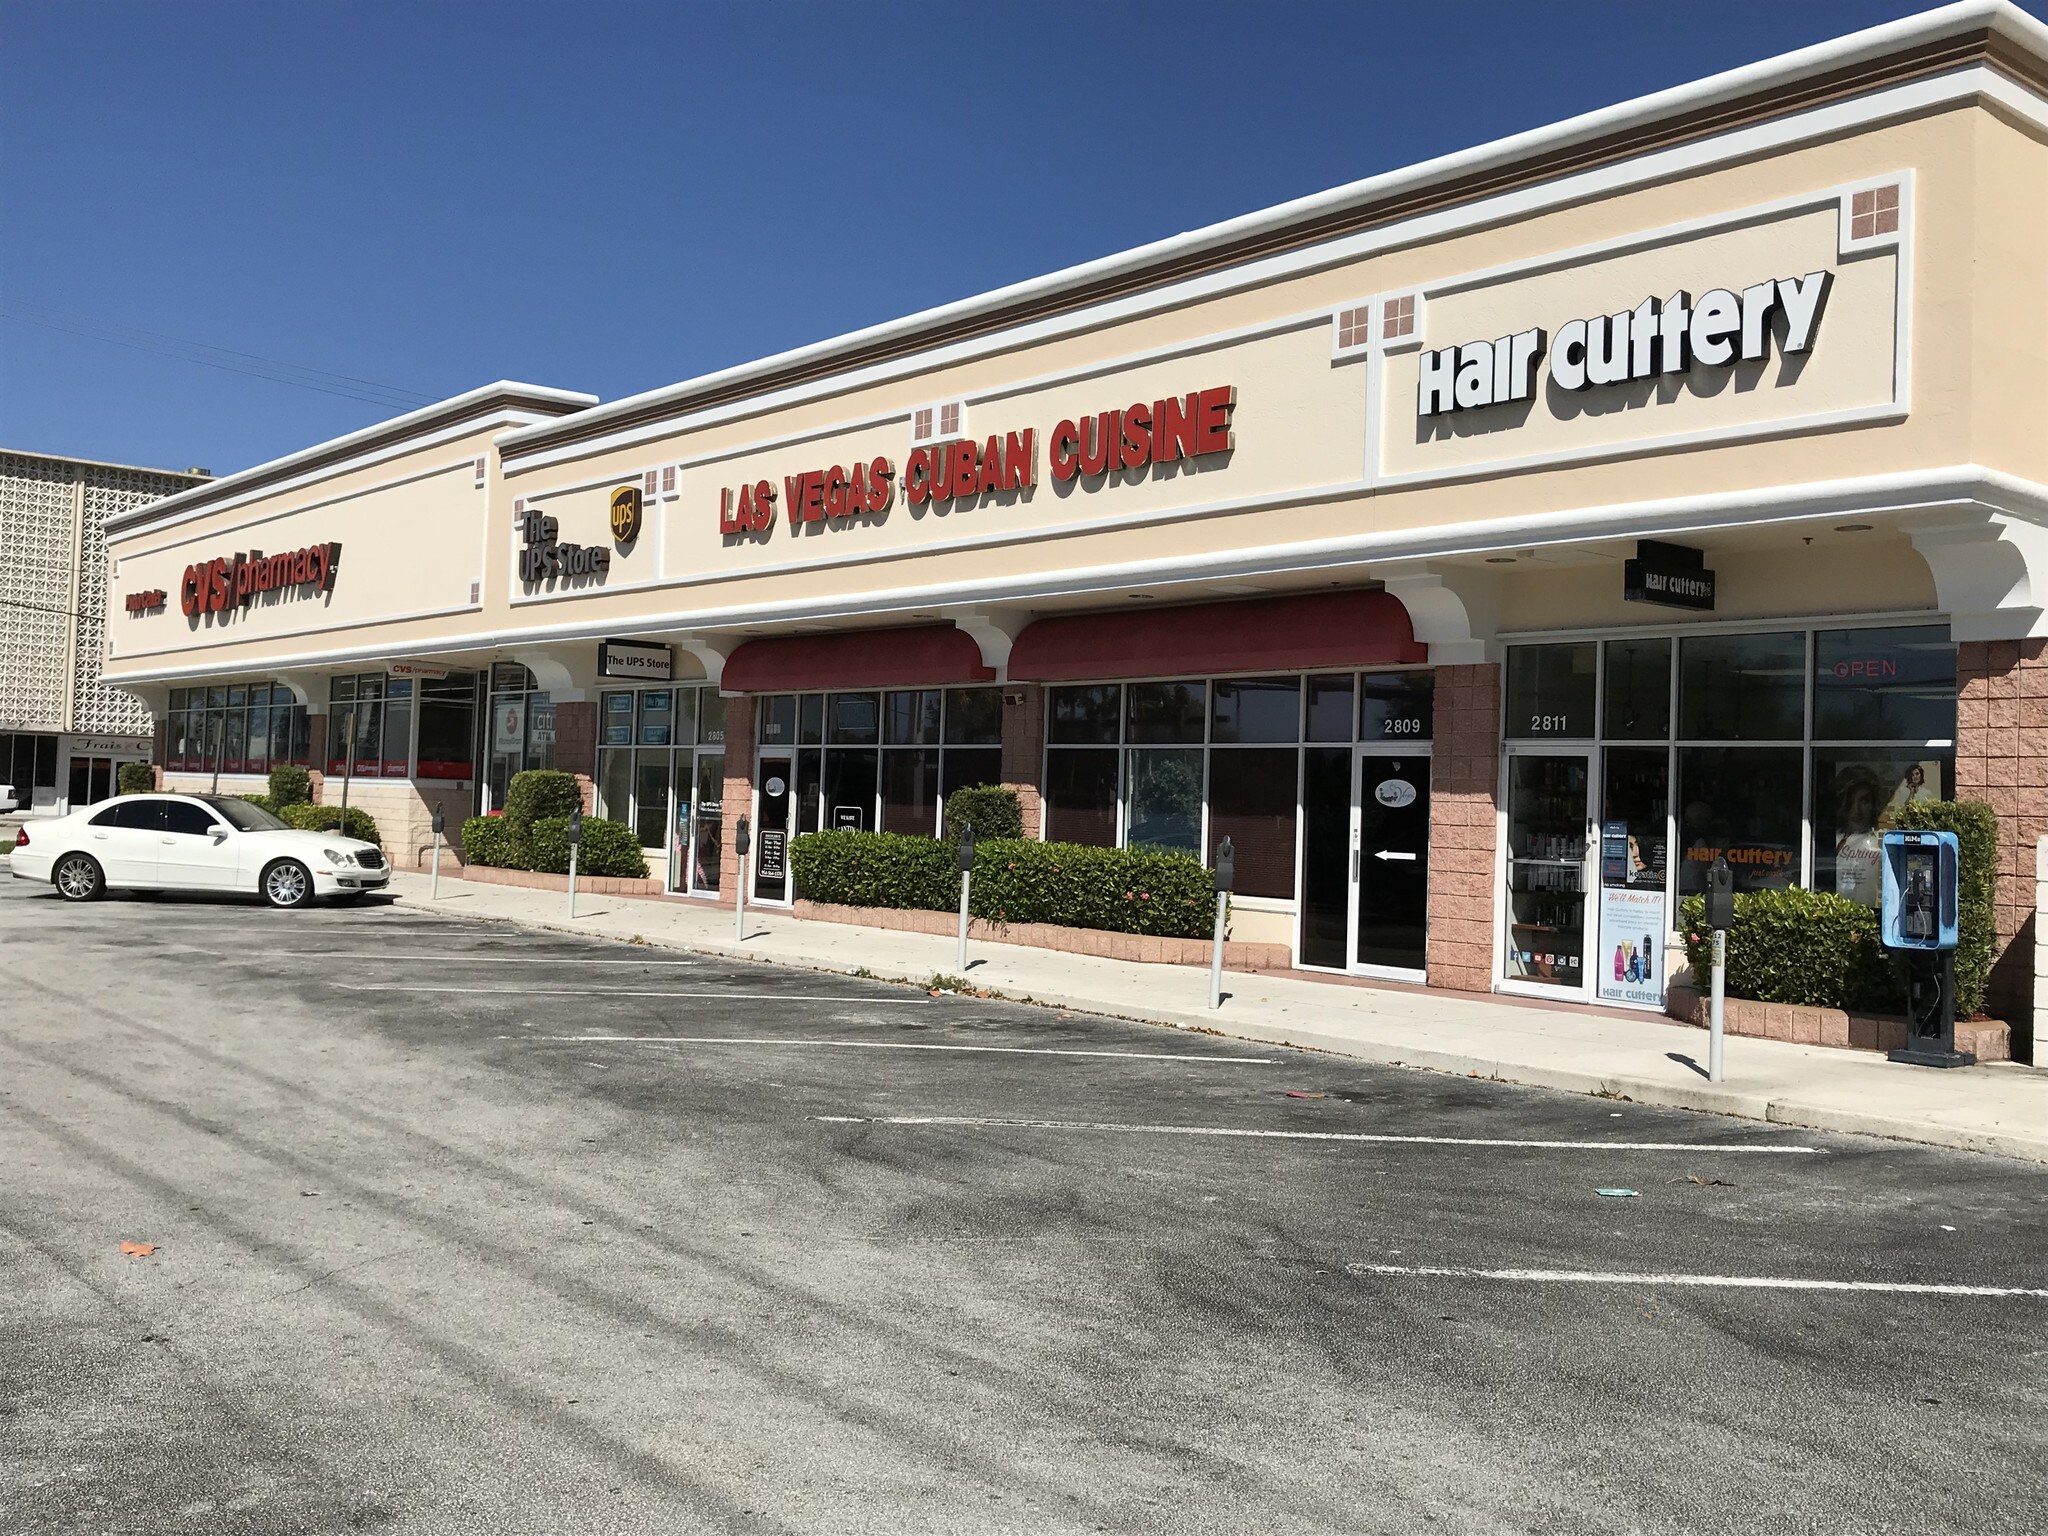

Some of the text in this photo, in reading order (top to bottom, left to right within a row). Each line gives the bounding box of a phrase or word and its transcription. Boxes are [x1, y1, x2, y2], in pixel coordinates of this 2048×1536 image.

[1419, 270, 1830, 416] Hair cuttery
[720, 386, 1236, 534] LAS VEGAS CUBAN CUISINE
[522, 510, 554, 543] The
[612, 503, 633, 534] ups
[519, 543, 602, 582] UPS Store
[181, 543, 335, 616] CVS/pharmacy
[1645, 573, 1668, 591] Hair
[607, 655, 670, 669] The UPS Store
[1834, 660, 1896, 677] OPEN
[1384, 719, 1421, 733] 2809
[1531, 715, 1567, 731] 2811
[708, 730, 725, 741] 2805
[1687, 847, 1793, 864] Hair cuttery
[1603, 988, 1623, 998] Hair
